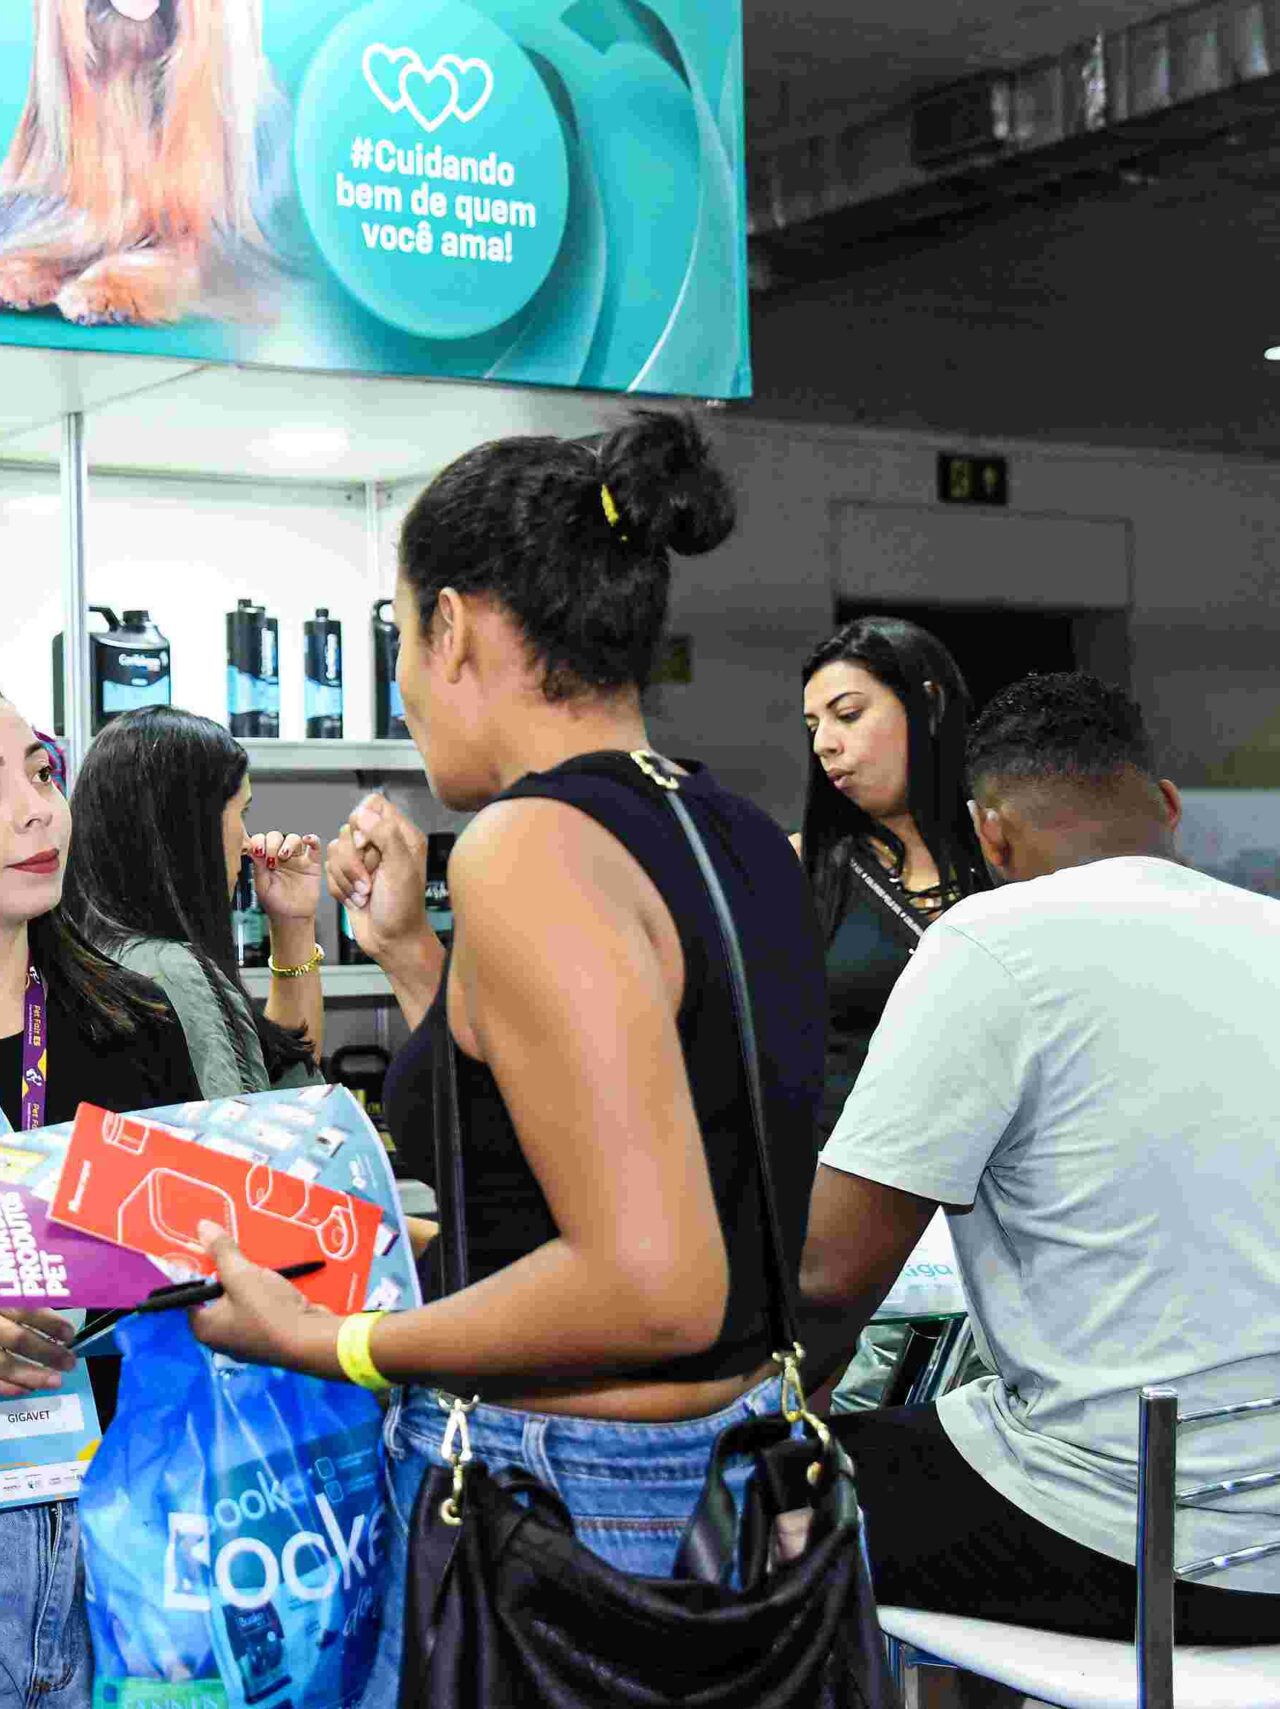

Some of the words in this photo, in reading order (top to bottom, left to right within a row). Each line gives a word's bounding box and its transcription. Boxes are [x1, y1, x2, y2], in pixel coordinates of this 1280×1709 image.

[350, 134, 515, 188] #Cuidando
[336, 172, 403, 213] bem
[410, 181, 448, 218] de
[455, 193, 536, 229] quem
[361, 219, 434, 255] você
[441, 230, 513, 264] ama!
[39, 1249, 71, 1297] PET
[904, 1262, 953, 1277] iga
[7, 1409, 51, 1424] GIGAVET
